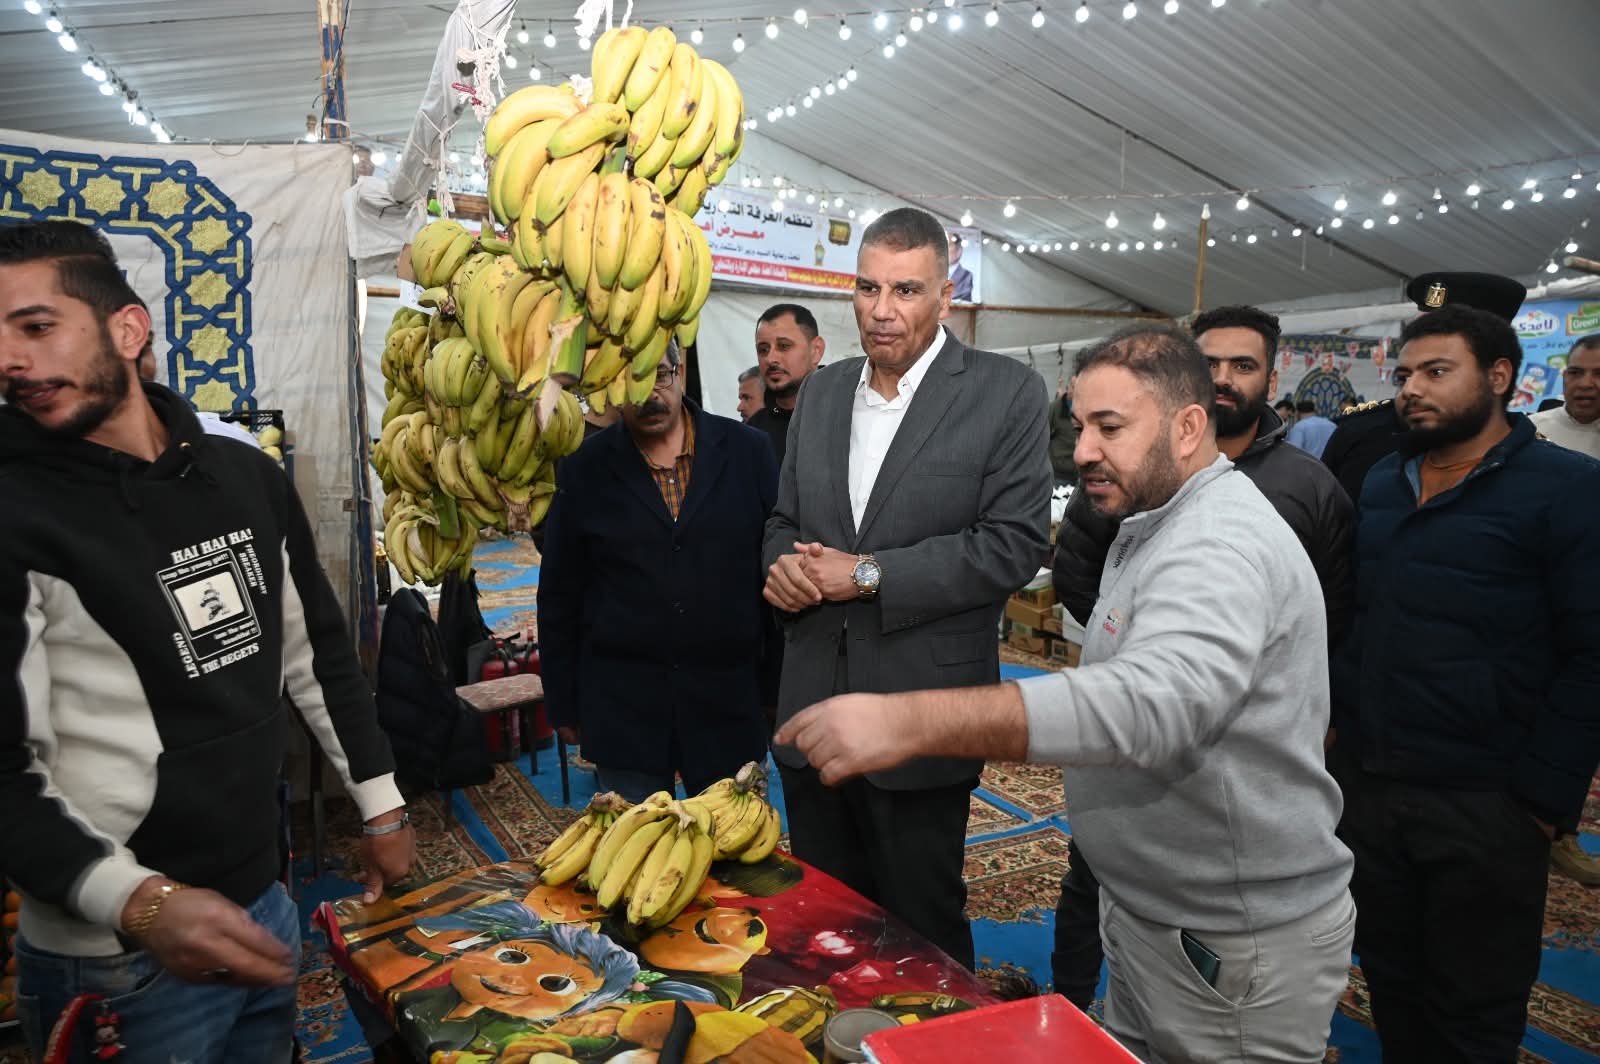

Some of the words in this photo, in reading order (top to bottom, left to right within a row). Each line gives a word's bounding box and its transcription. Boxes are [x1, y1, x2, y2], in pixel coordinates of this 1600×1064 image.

[746, 203, 783, 224] الغرفة
[716, 222, 765, 240] معرض
[171, 545, 200, 564] HAI
[199, 535, 228, 554] HAI
[227, 528, 254, 545] HA!
[201, 659, 221, 675] THE
